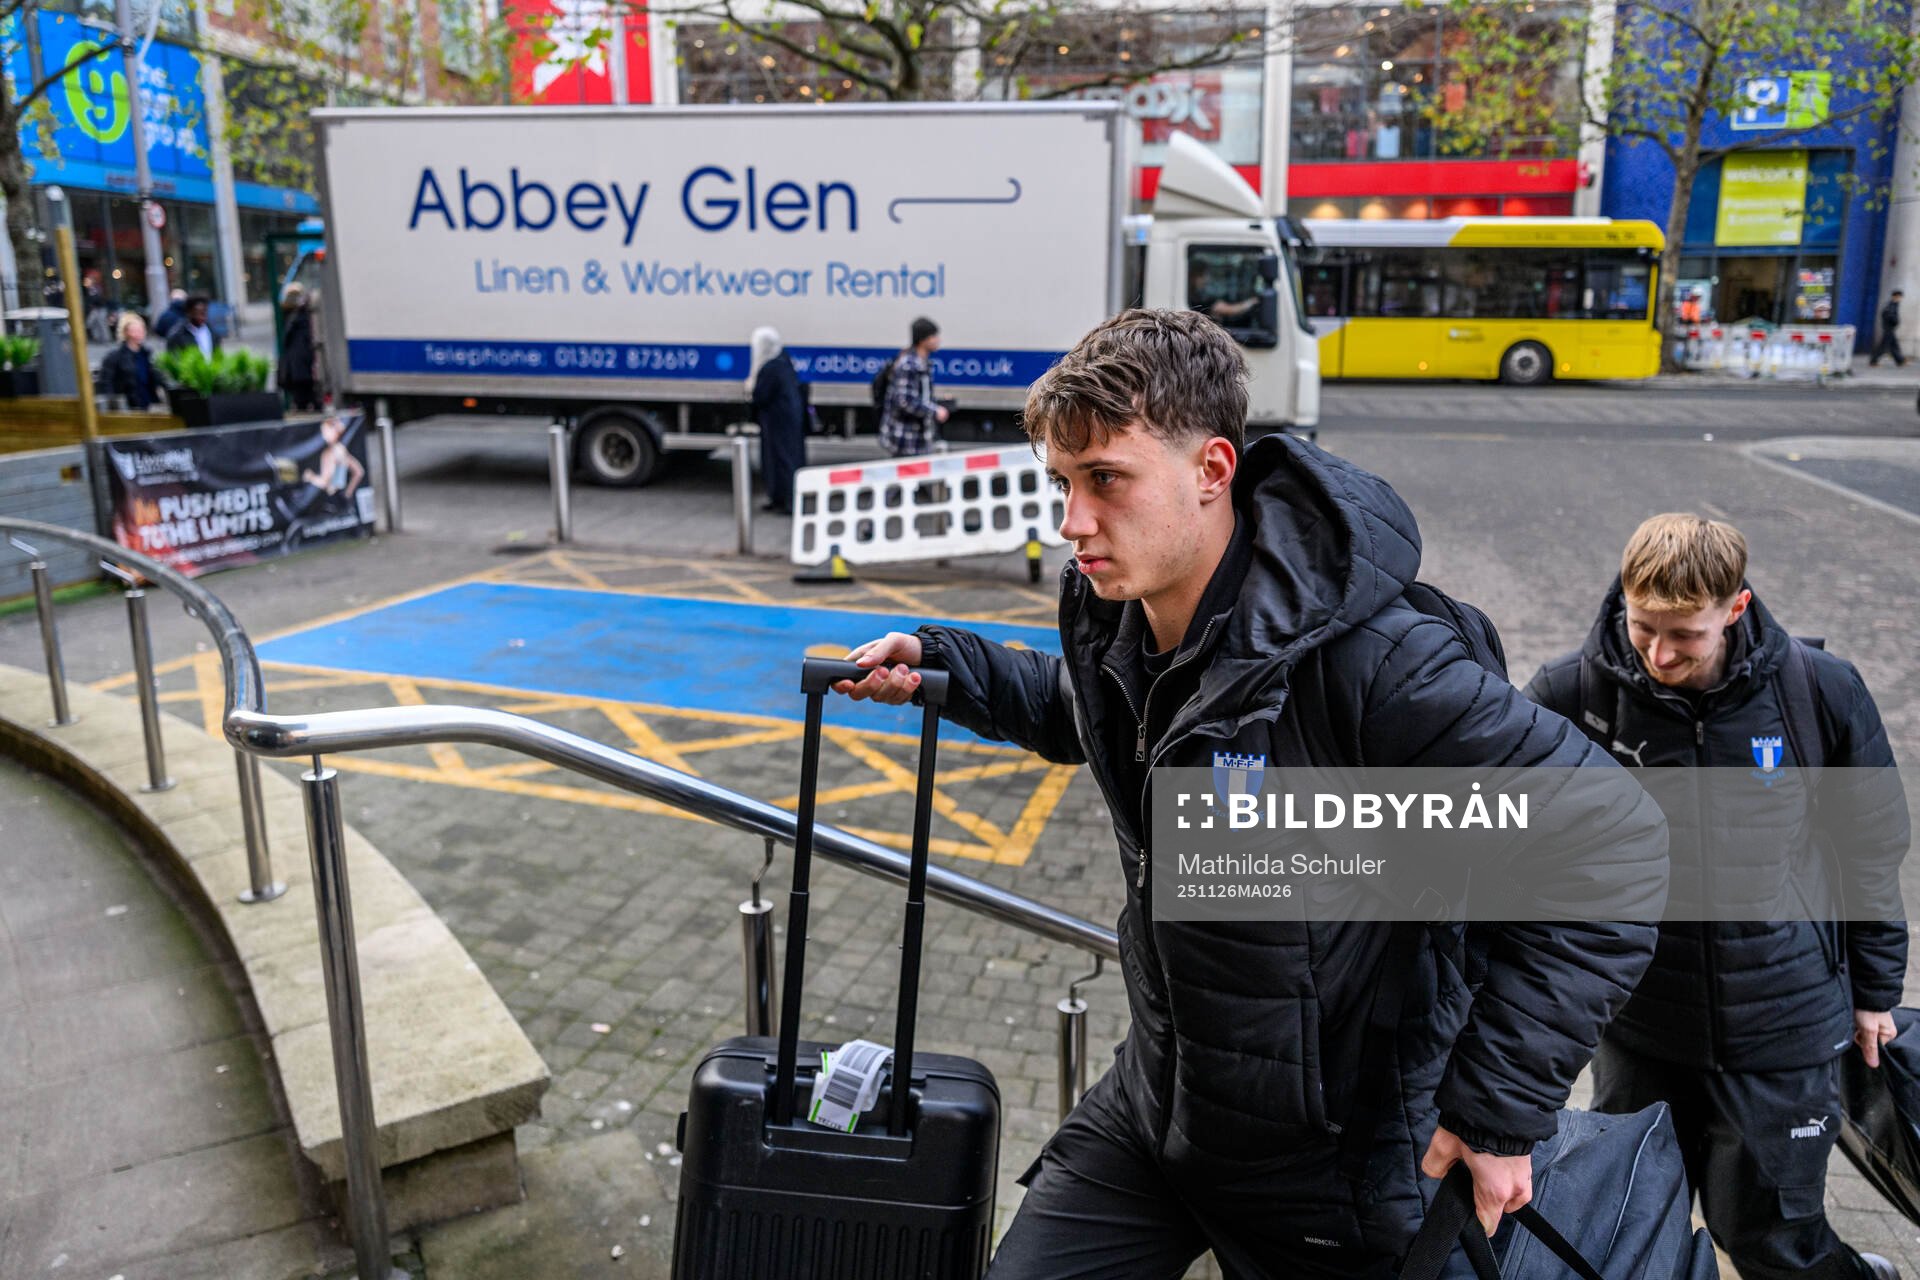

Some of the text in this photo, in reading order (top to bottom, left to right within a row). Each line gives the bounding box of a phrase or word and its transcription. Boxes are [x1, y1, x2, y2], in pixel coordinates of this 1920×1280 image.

[409, 165, 859, 247] Abbey Glen
[475, 259, 945, 298] Linen & Workwear Rental
[426, 343, 700, 371] Telephone: 01302 873619
[1790, 1125, 1820, 1140] PUMA
